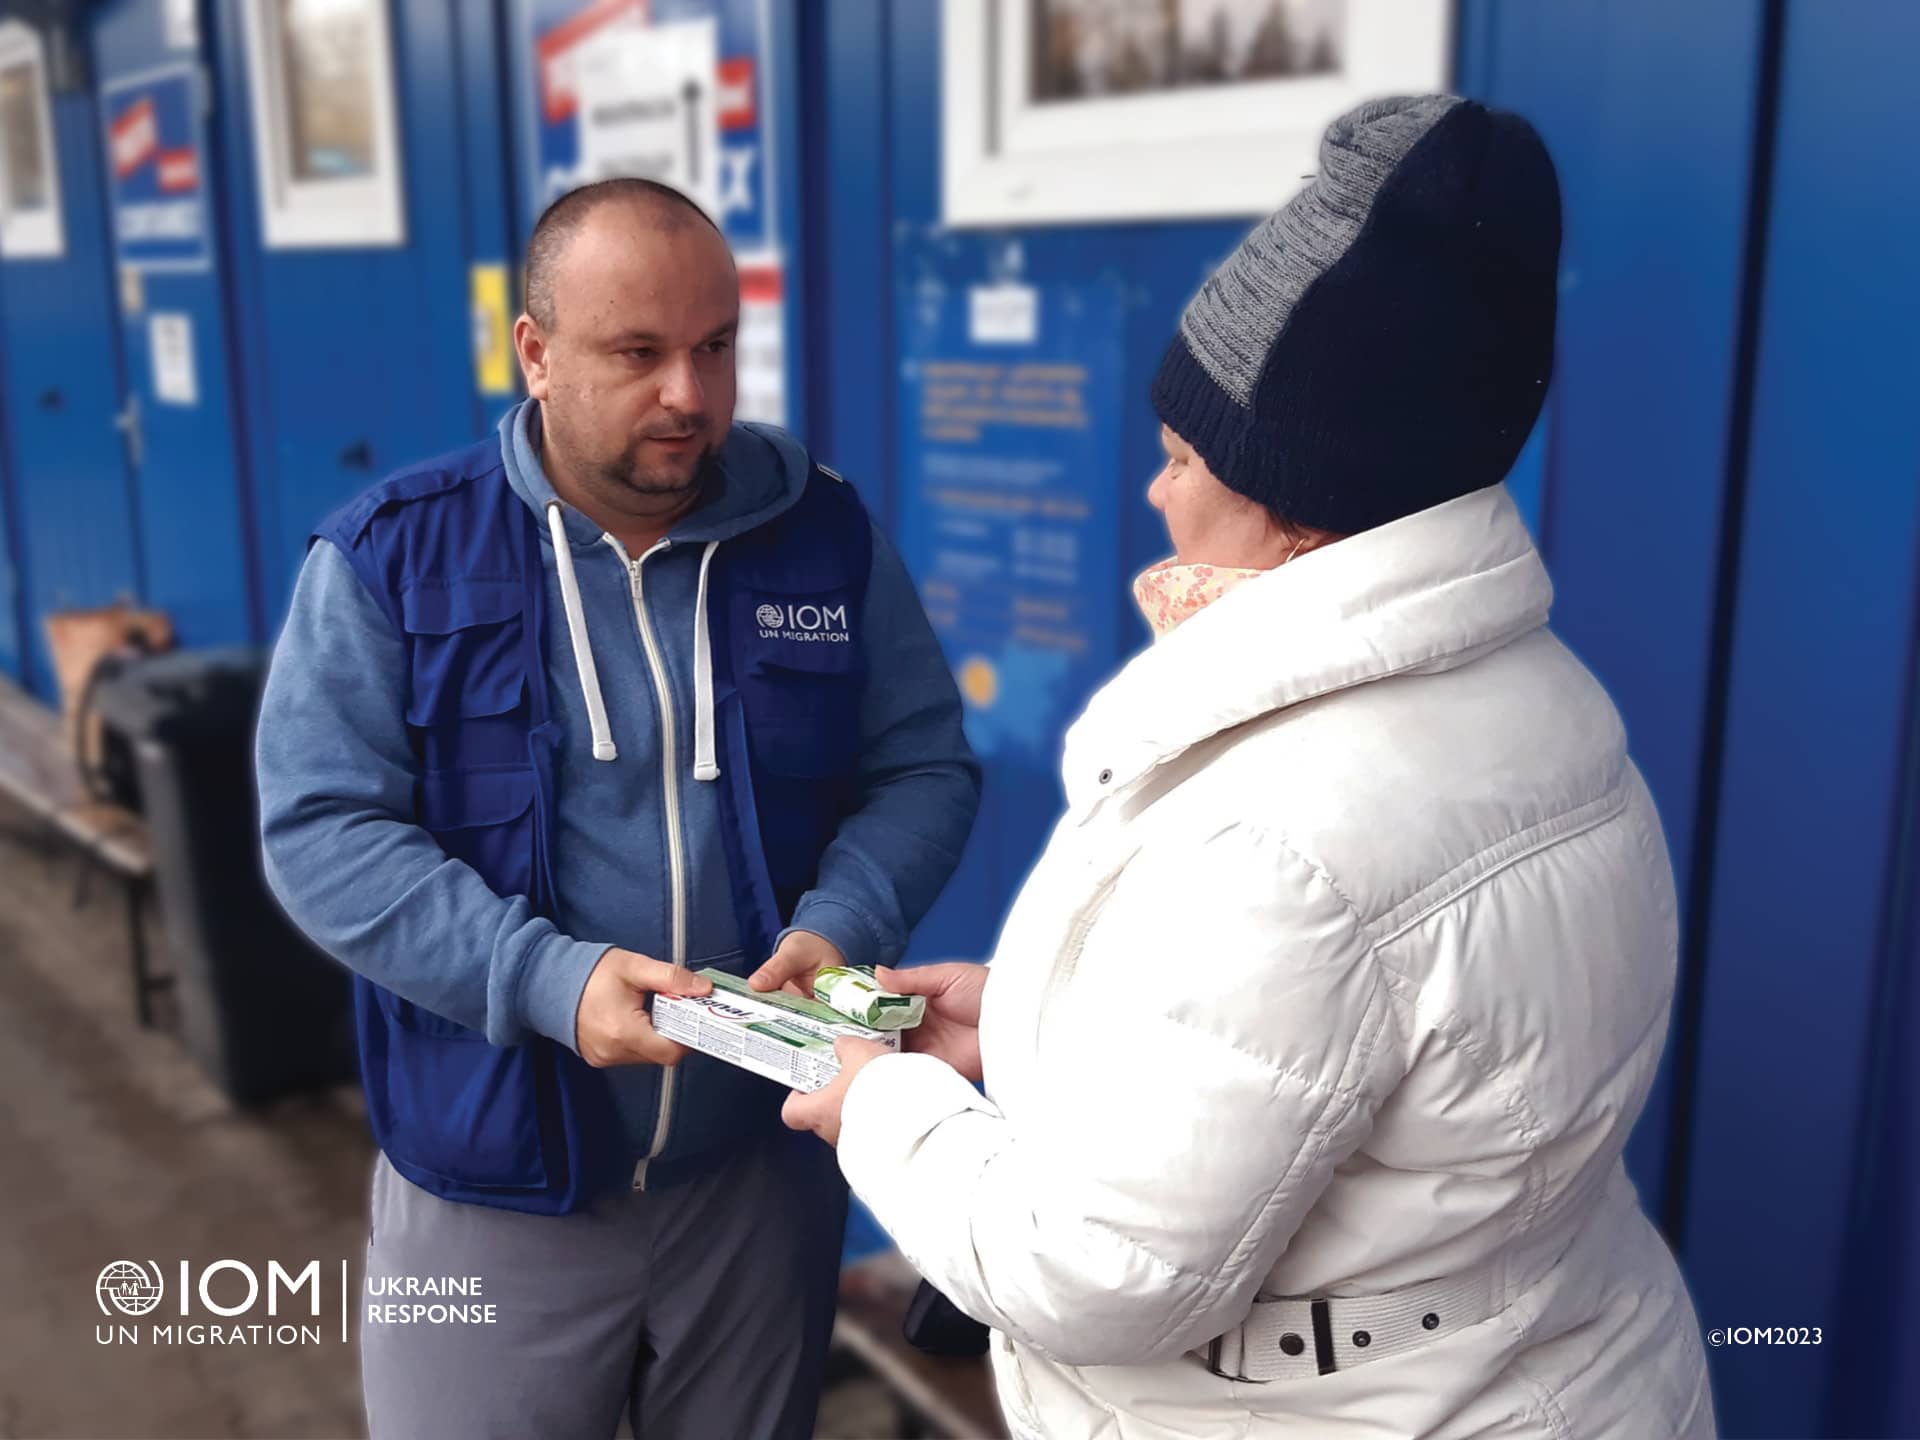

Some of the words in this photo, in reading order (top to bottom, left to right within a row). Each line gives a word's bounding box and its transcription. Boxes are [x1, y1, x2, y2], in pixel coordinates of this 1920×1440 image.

[788, 604, 847, 630] IOM
[759, 630, 779, 639] UN
[782, 630, 849, 642] MIGRATION
[681, 995, 753, 1016] ignal
